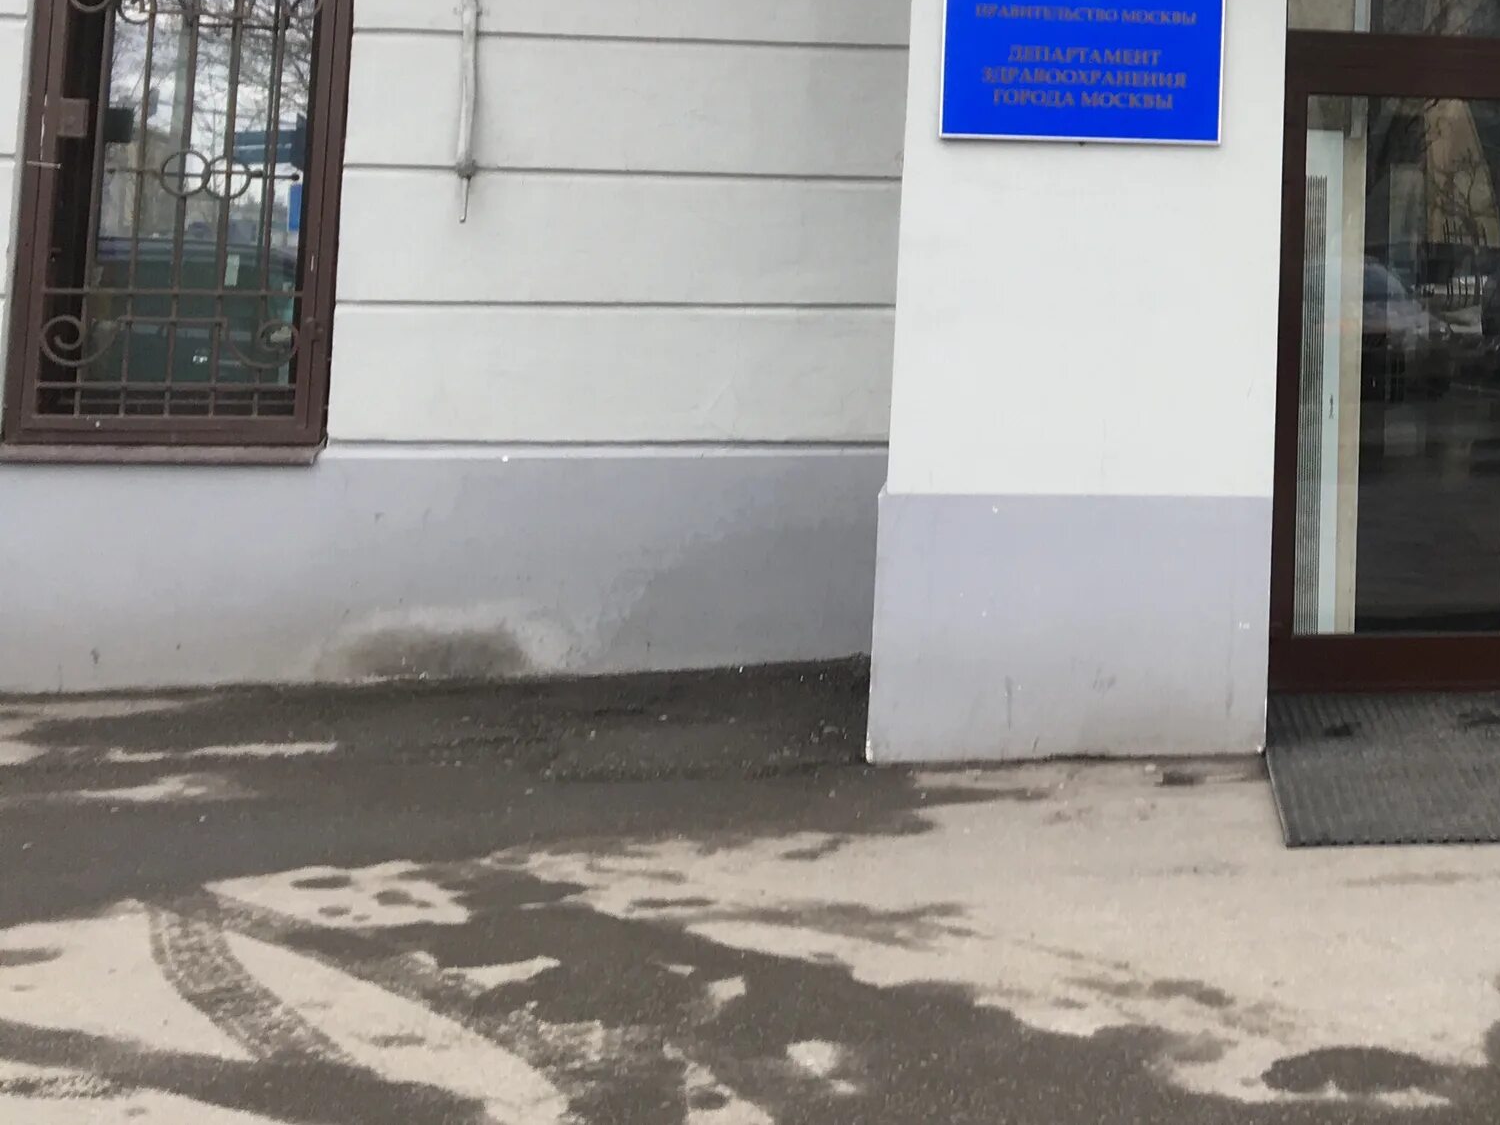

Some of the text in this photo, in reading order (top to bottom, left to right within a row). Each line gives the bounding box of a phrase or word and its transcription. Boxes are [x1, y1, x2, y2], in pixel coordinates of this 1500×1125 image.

[976, 3, 1197, 24] ПРАВИТЕЛЬСТВО МОСКВЫ
[1008, 45, 1162, 65] ДЕПАРТАМЕНТ
[982, 67, 1187, 88] ЗДРАВООХРАНЕНИЯ
[993, 89, 1173, 109] ГОРОДА МОСКВЫ
